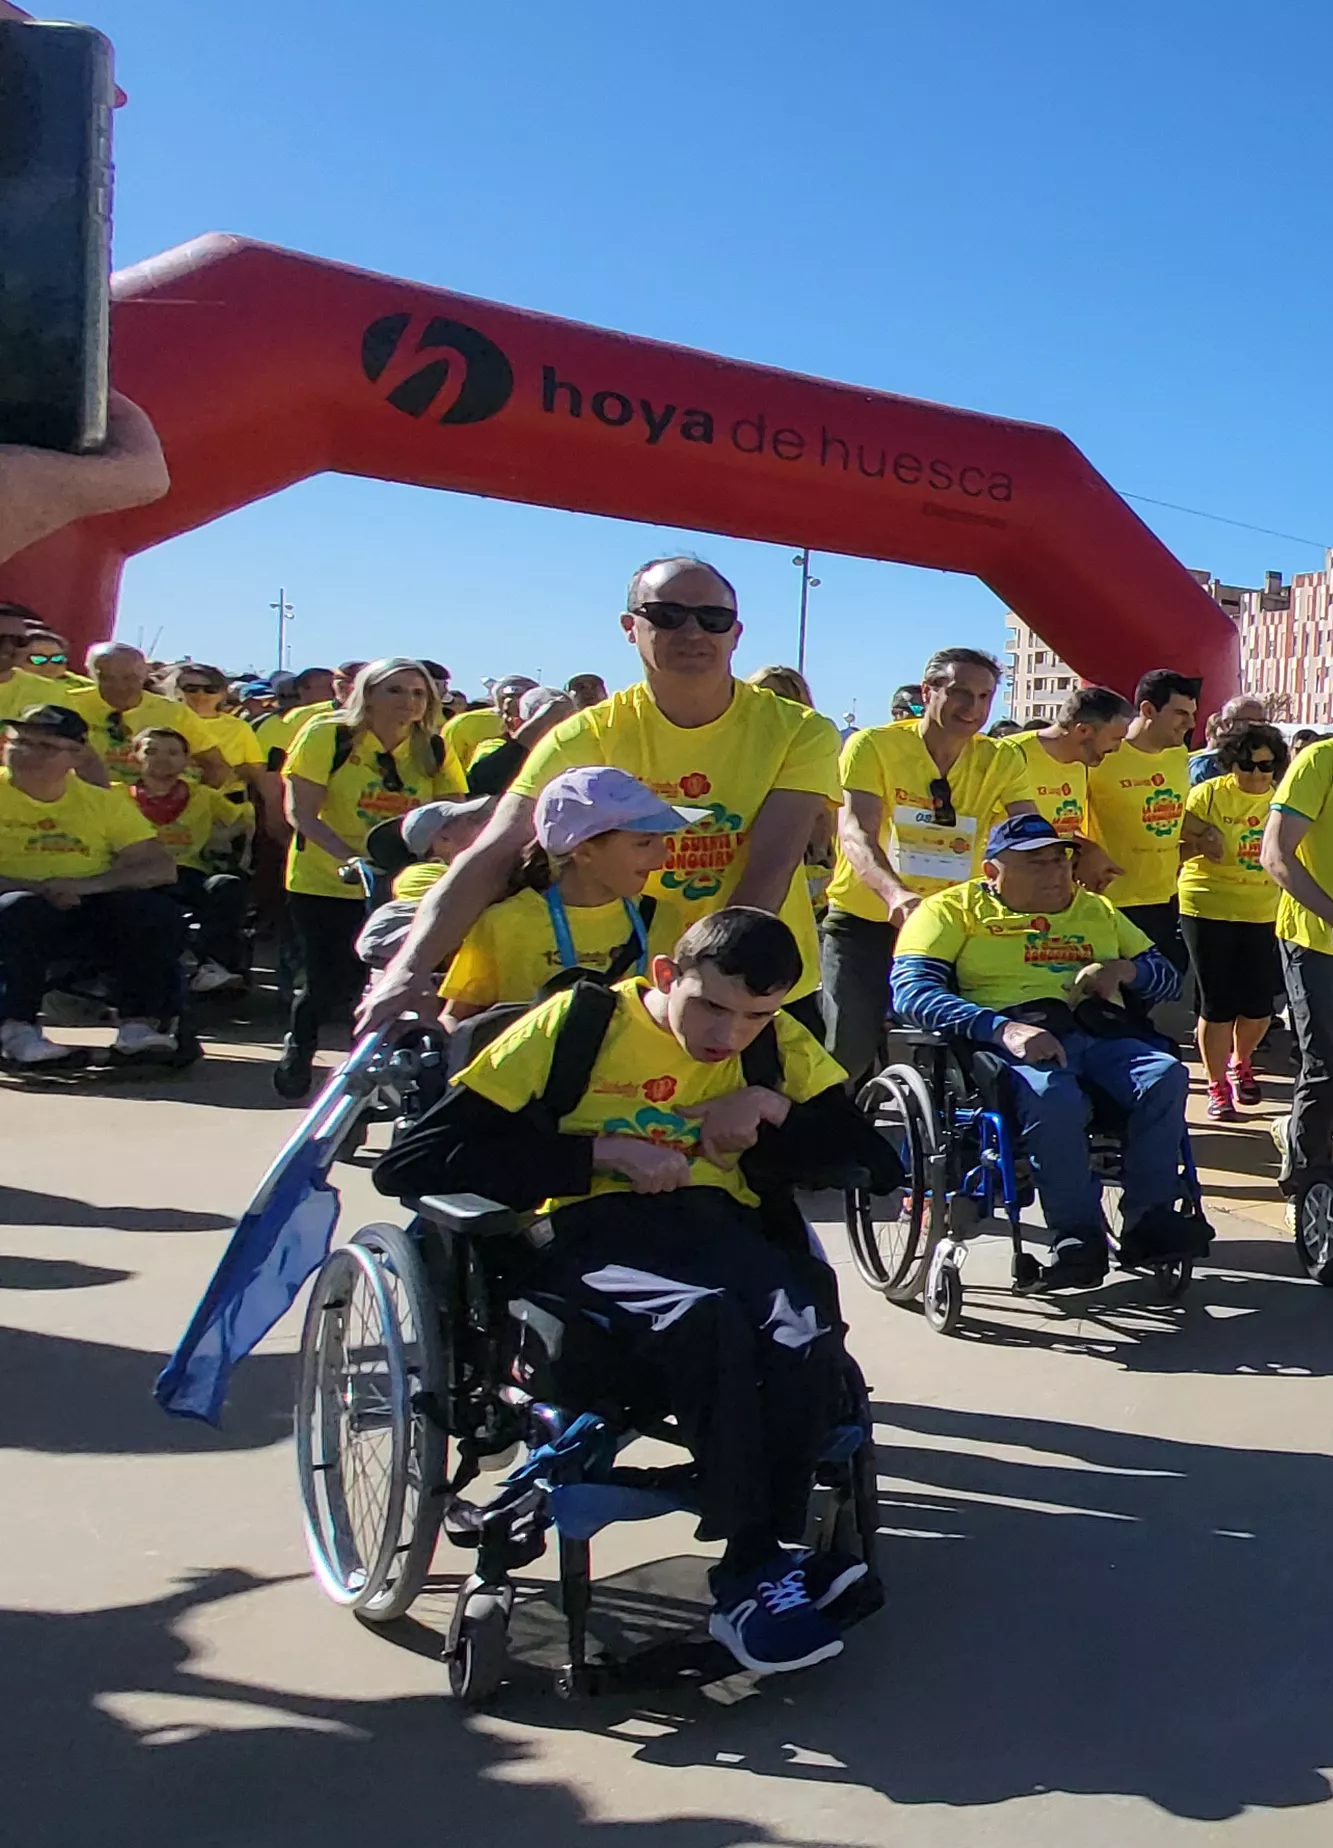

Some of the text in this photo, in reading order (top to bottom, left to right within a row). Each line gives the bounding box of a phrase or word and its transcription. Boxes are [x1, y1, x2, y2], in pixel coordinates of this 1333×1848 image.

[541, 365, 1013, 502] hoya de huesca
